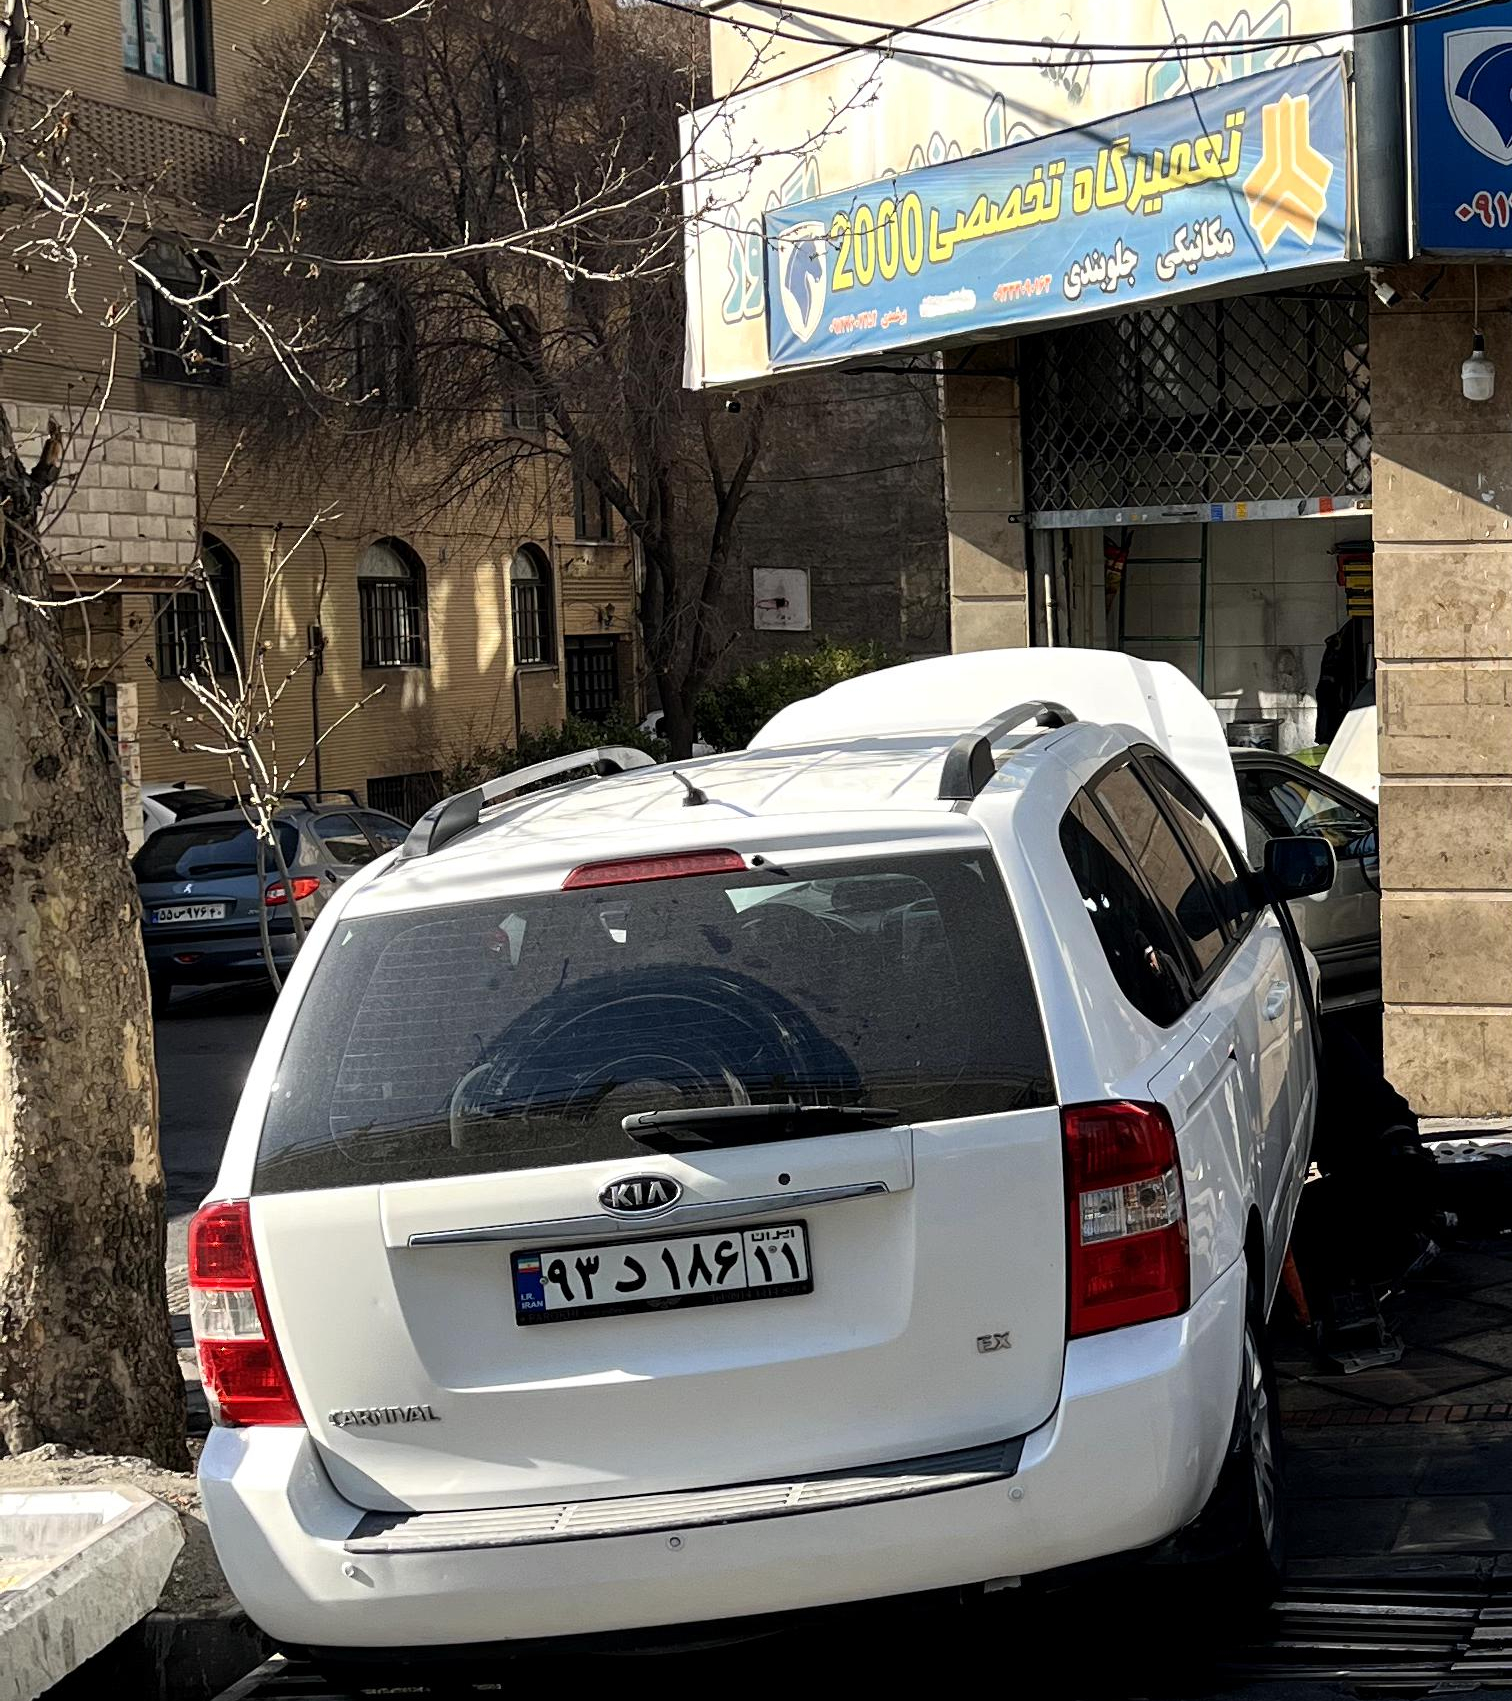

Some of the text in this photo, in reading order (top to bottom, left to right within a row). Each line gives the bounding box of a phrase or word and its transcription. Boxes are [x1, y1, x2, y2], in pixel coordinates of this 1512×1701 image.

[1073, 107, 1246, 216] تعمیرگاه
[929, 158, 1066, 262] تخصصی
[830, 190, 924, 292] 2000
[1063, 215, 1235, 300] مکانیکی جلوبندی
[611, 1180, 668, 1207] KIA
[751, 1229, 795, 1242] ایران
[521, 1300, 544, 1309] IRAN
[977, 1331, 1012, 1353] EX
[328, 1404, 442, 1428] CARNIVAL
